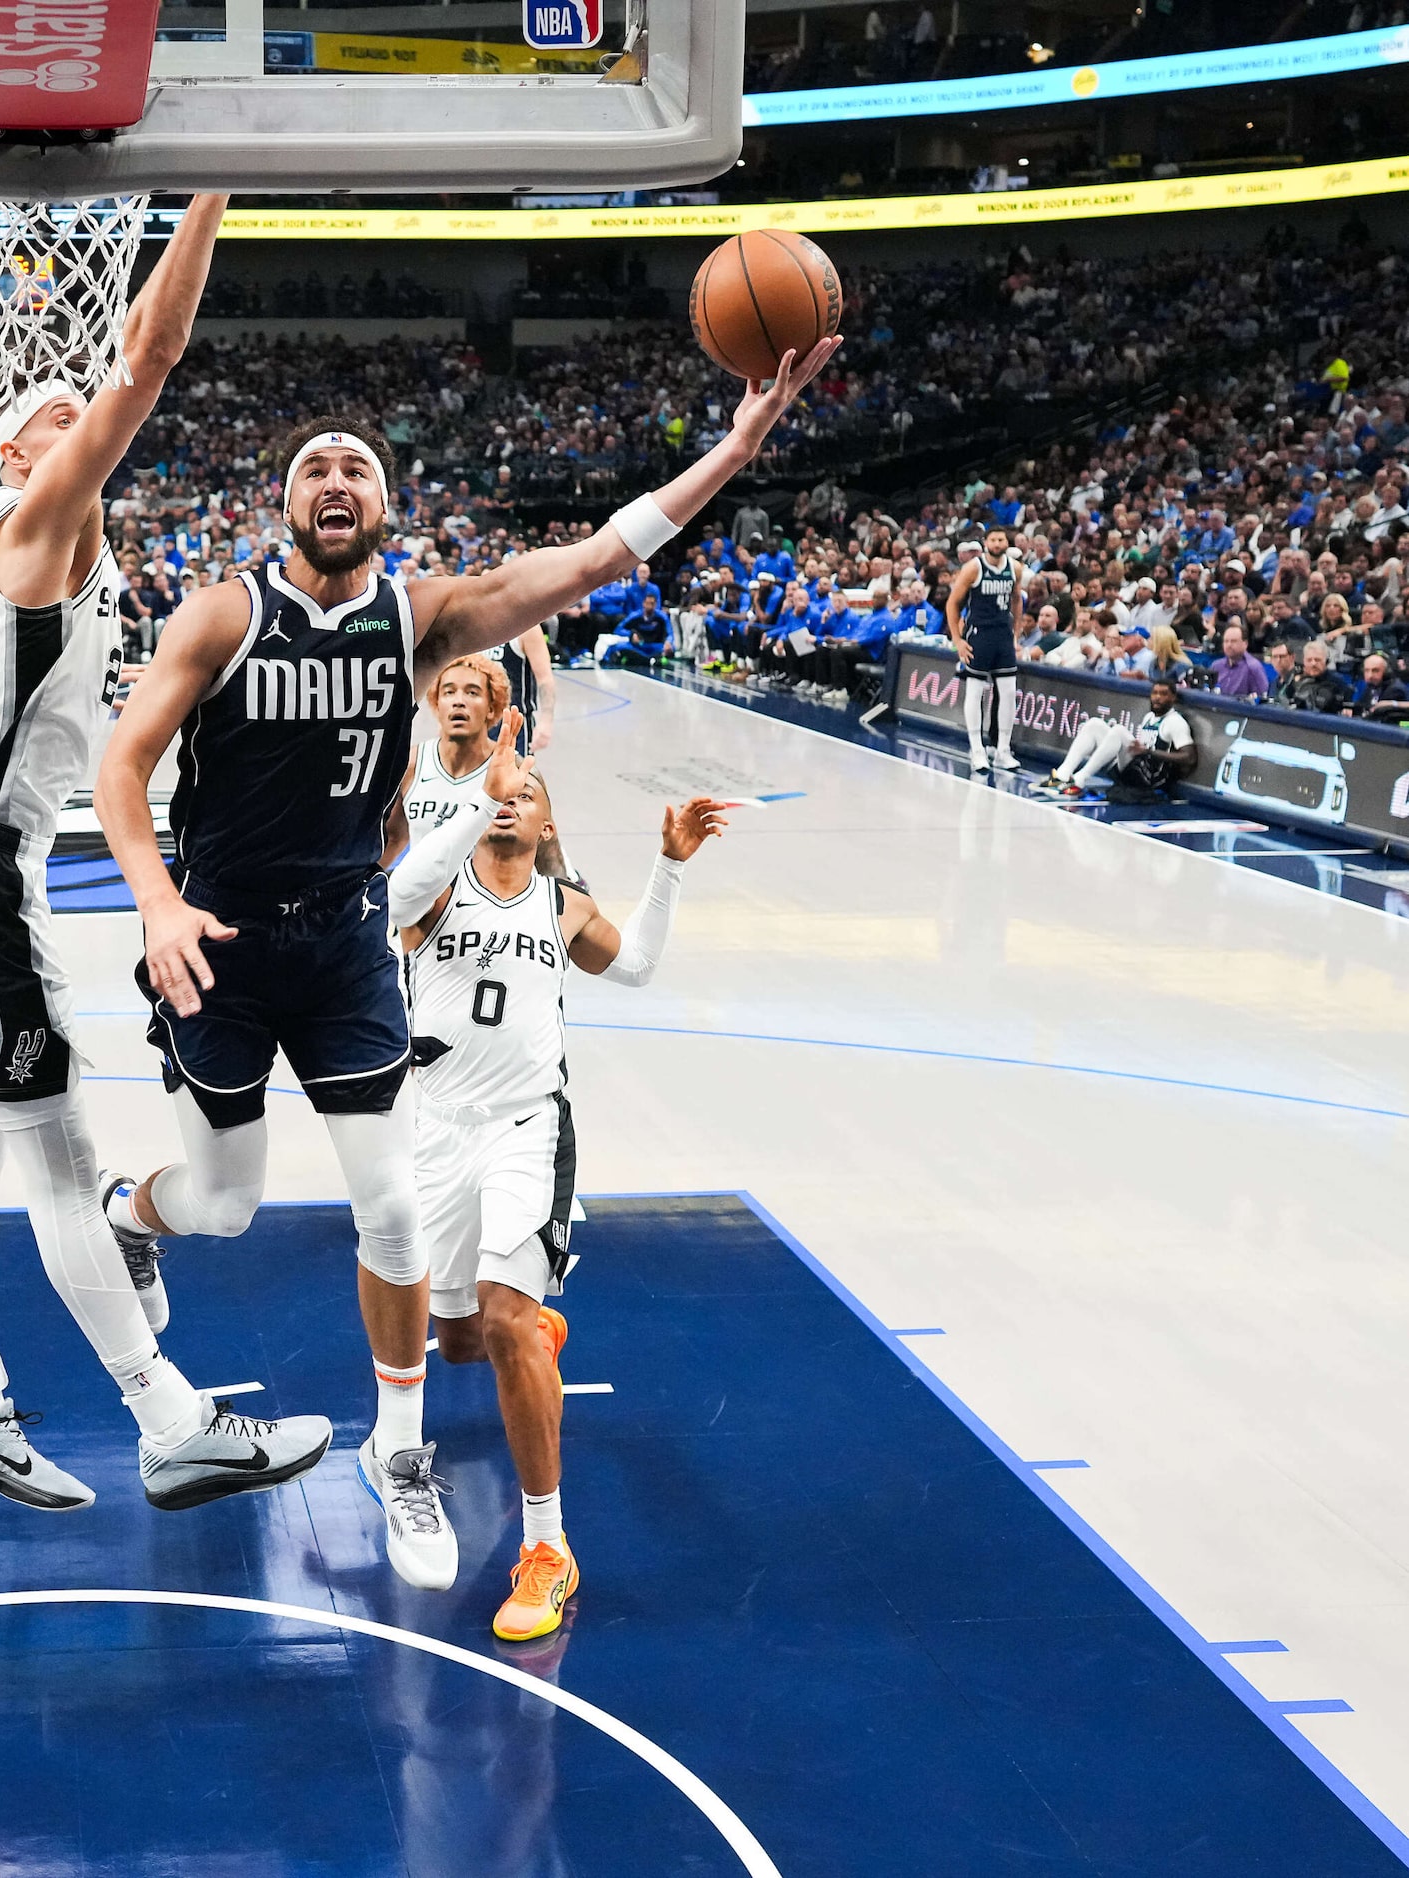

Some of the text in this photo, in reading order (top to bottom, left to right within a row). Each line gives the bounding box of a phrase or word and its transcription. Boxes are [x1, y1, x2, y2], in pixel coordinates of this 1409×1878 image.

[535, 7, 574, 37] NBA
[977, 203, 1018, 213] WINDOW
[1071, 192, 1136, 208] REPLACEMENT
[345, 617, 392, 634] chime
[246, 657, 398, 721] MAVS
[1015, 688, 1058, 733] 2025
[330, 728, 385, 797] 31
[436, 931, 556, 971] SPURS
[471, 978, 509, 1029] 0
